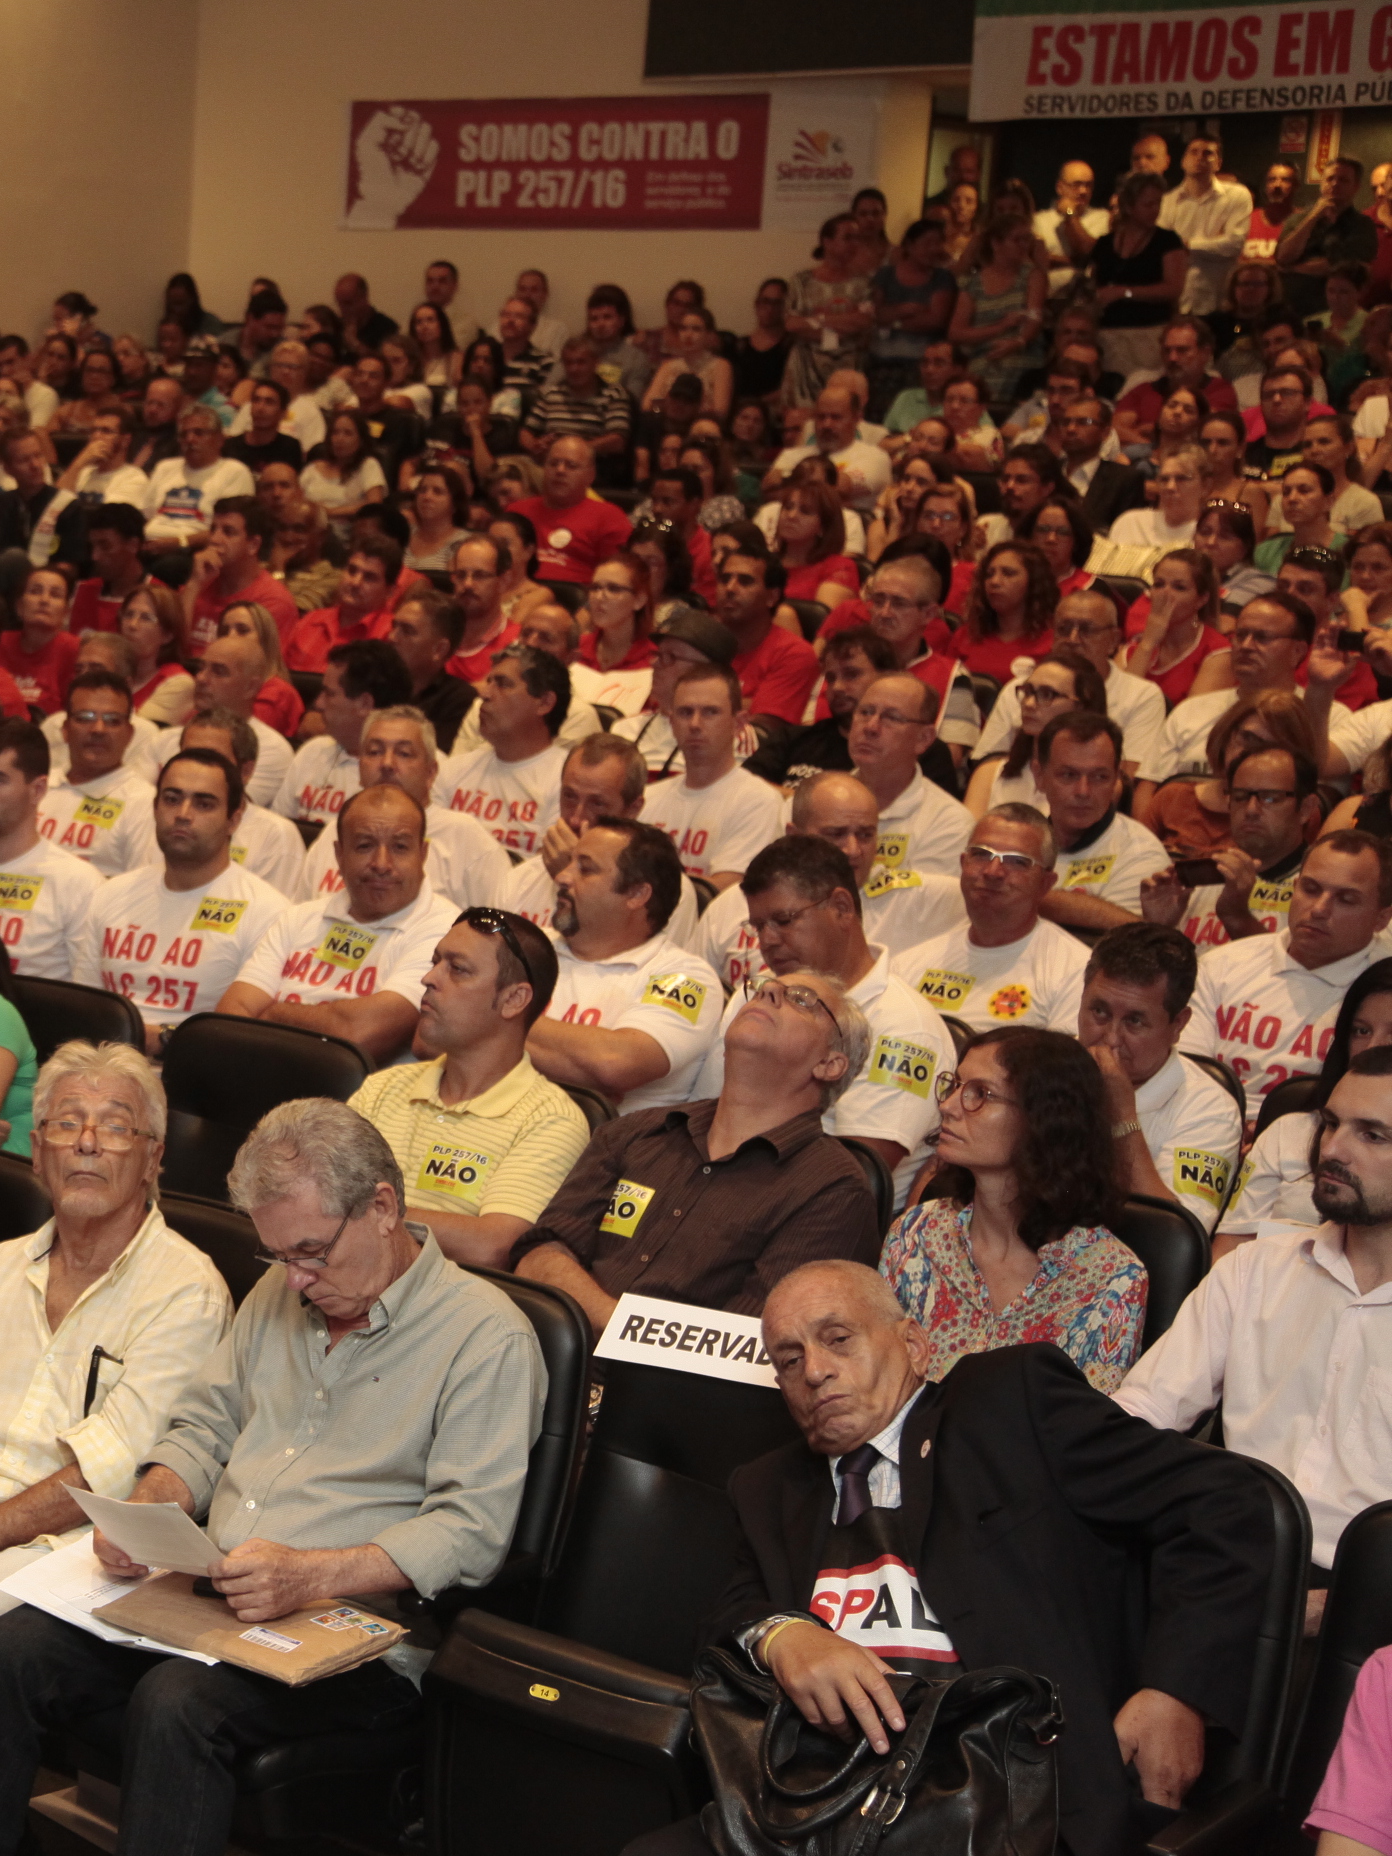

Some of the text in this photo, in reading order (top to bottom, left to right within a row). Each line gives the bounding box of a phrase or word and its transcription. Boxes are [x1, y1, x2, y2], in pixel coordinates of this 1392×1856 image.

[1026, 15, 1263, 87] ESTAMOS
[1272, 8, 1355, 77] EM
[1022, 89, 1159, 117] SERVIDORES
[1164, 90, 1195, 114] DA
[1201, 82, 1347, 112] DEFENSORIA
[458, 119, 741, 163] SOMOS CONTRA O
[455, 169, 510, 209] PLP
[516, 167, 628, 209] 257/16
[82, 803, 115, 820] NÃO
[299, 784, 346, 814] NÃO
[450, 788, 503, 822] NÃO
[59, 822, 96, 849] AO
[876, 843, 900, 856] ÃO
[198, 908, 237, 924] NÃO
[101, 924, 204, 969] NÃO AO
[325, 936, 366, 961] NÃO
[281, 947, 378, 998] NÃO AO
[144, 975, 200, 1013] 257
[650, 982, 697, 1010] NÃO
[919, 981, 962, 1001] NÃO
[1215, 1001, 1283, 1051] NÃO
[880, 1038, 935, 1063] PLP 257/16
[877, 1052, 929, 1083] NÃO
[433, 1144, 488, 1167] PLP 257/16
[1178, 1150, 1201, 1160] PLP
[424, 1158, 478, 1185] NÃO
[1180, 1163, 1225, 1194] NÃO
[607, 1193, 637, 1219] ÃO
[540, 1688, 550, 1697] 14
